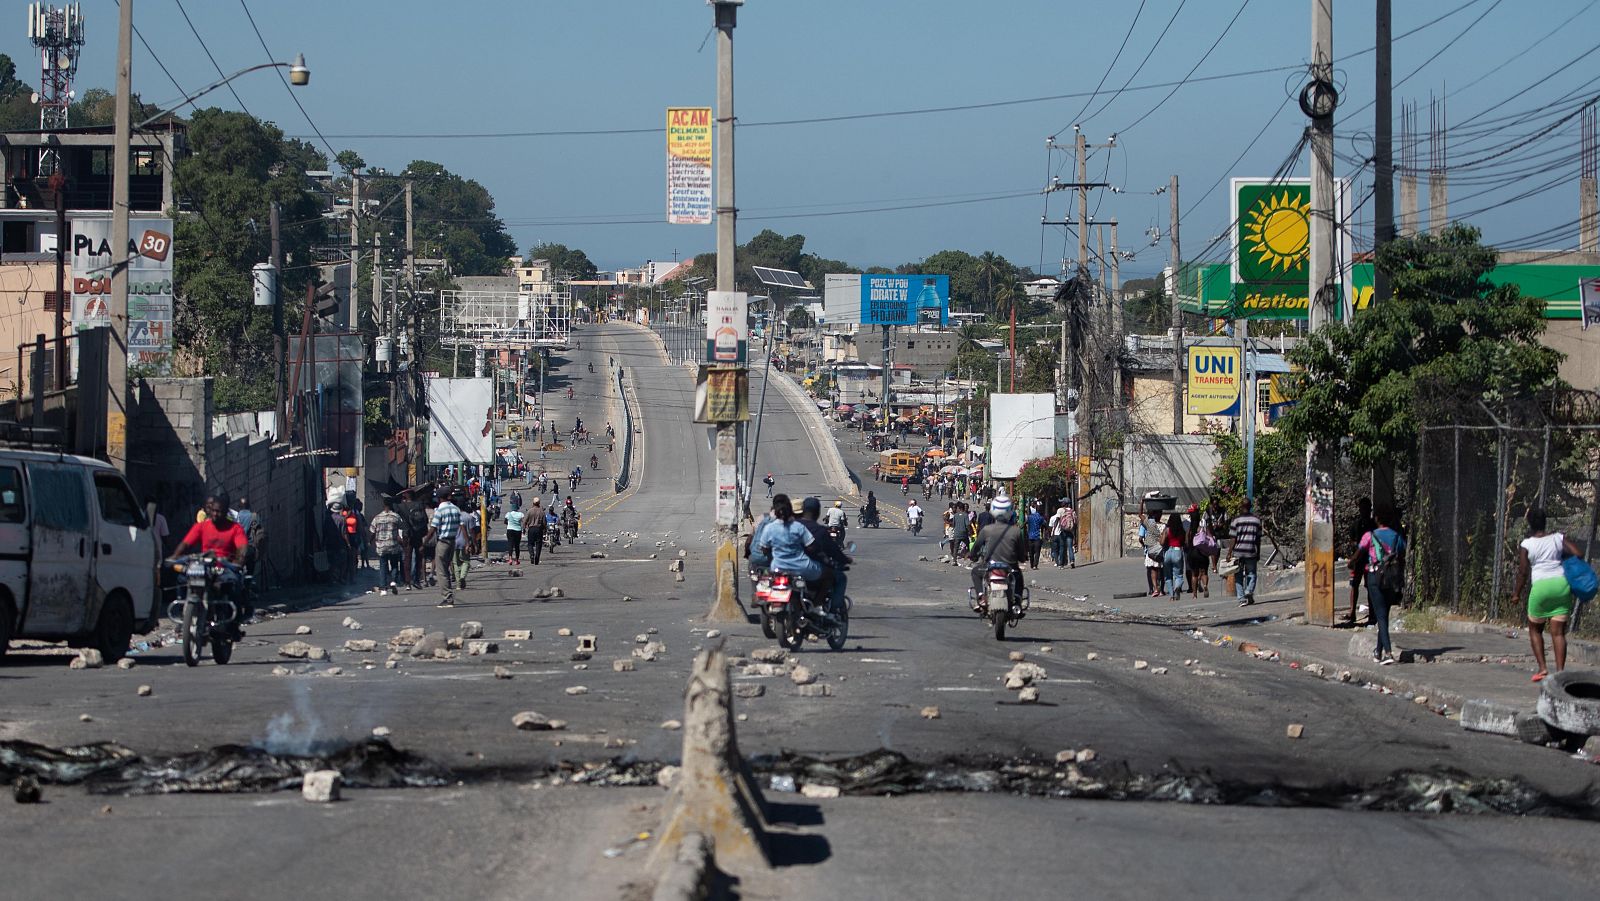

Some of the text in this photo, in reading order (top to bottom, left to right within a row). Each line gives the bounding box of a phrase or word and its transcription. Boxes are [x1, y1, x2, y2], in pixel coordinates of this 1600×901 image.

[672, 110, 708, 126] ACAM
[74, 234, 166, 256] PLAA 30
[870, 288, 908, 301] IDRATE W
[1195, 355, 1234, 374] UNI
[1195, 376, 1234, 385] TRANSFER
[1312, 562, 1331, 589] 21
